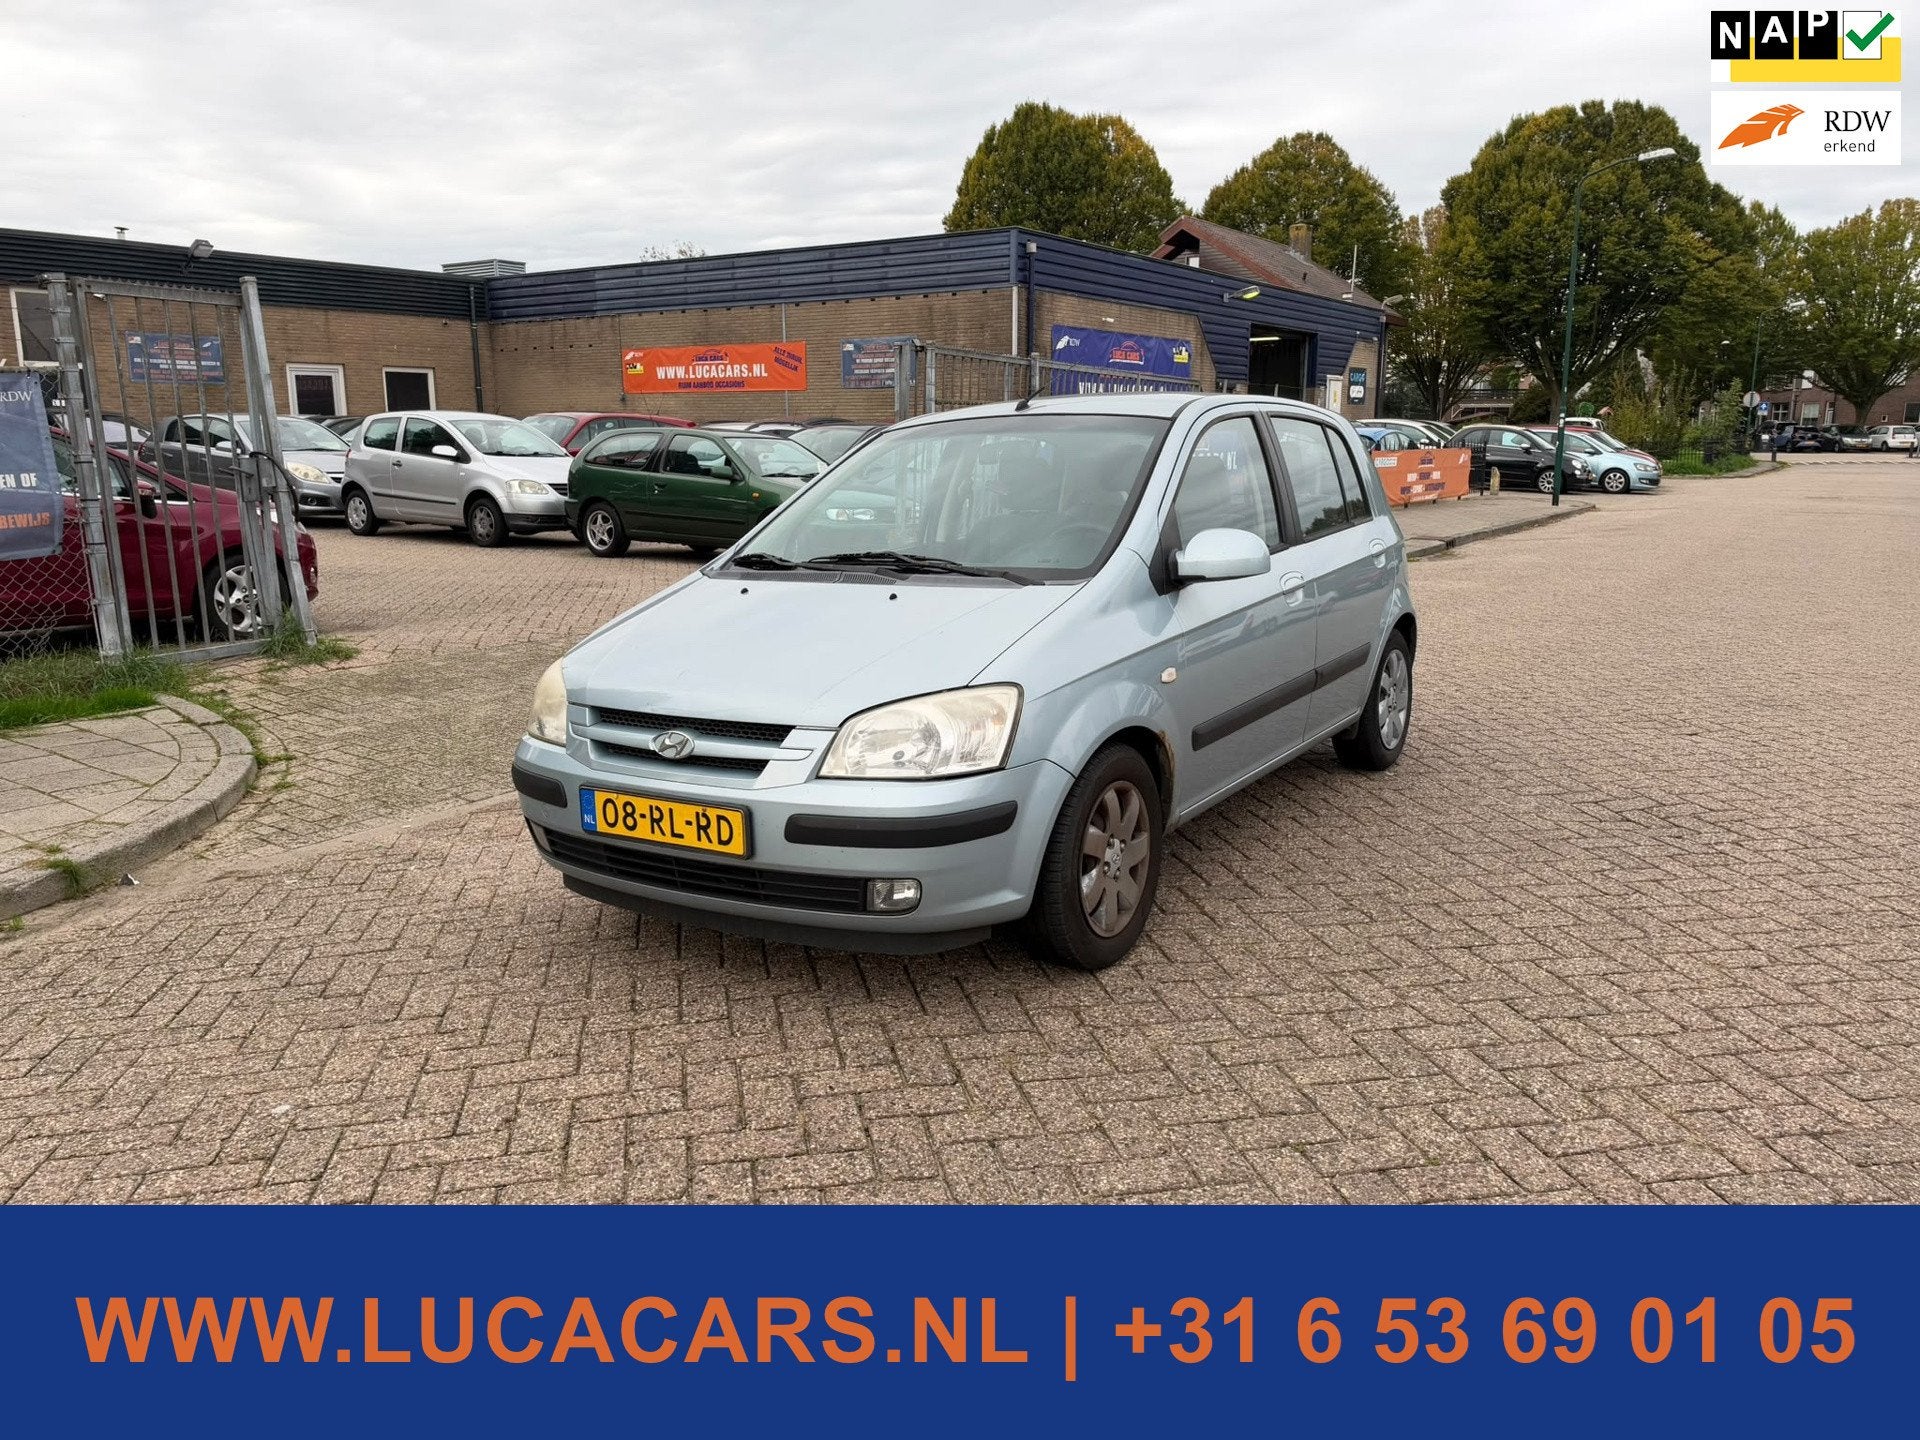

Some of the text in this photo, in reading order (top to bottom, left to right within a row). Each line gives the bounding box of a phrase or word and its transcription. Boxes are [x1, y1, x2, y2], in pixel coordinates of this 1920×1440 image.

[695, 354, 724, 362] LUCA CARS
[656, 363, 769, 380] WWW.LUCACARS.NL
[715, 380, 746, 389] OCCASIONS
[0, 390, 33, 402] RDW
[20, 472, 38, 488] OF
[584, 797, 734, 847] NL 08-RL-RD
